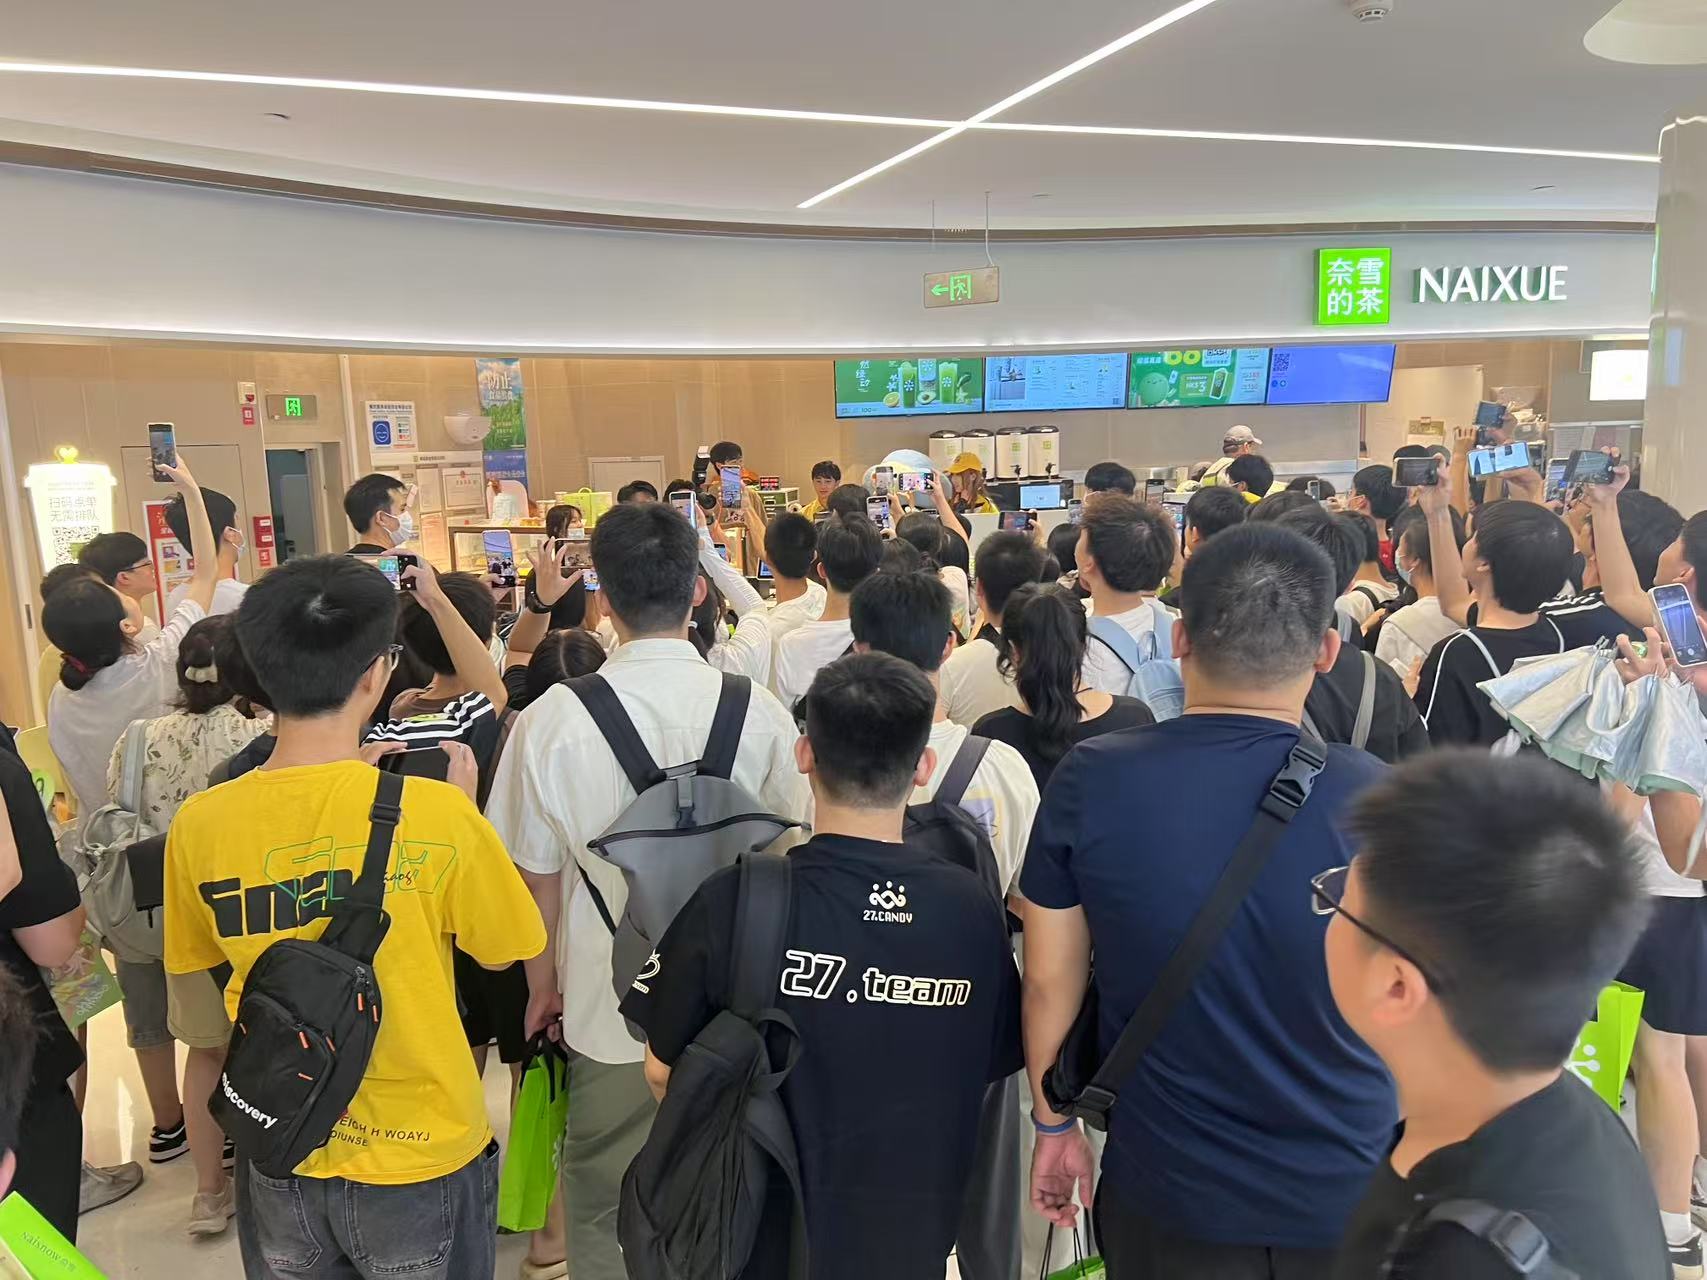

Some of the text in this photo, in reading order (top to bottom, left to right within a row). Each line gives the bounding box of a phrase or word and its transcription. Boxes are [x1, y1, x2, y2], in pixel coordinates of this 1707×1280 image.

[1327, 258, 1385, 286] 奈雪
[1416, 265, 1569, 304] NAIXUE
[1327, 288, 1384, 316] 的茶
[50, 510, 99, 523] 无需排队
[780, 949, 971, 1006] 27.team
[371, 1127, 380, 1137] H
